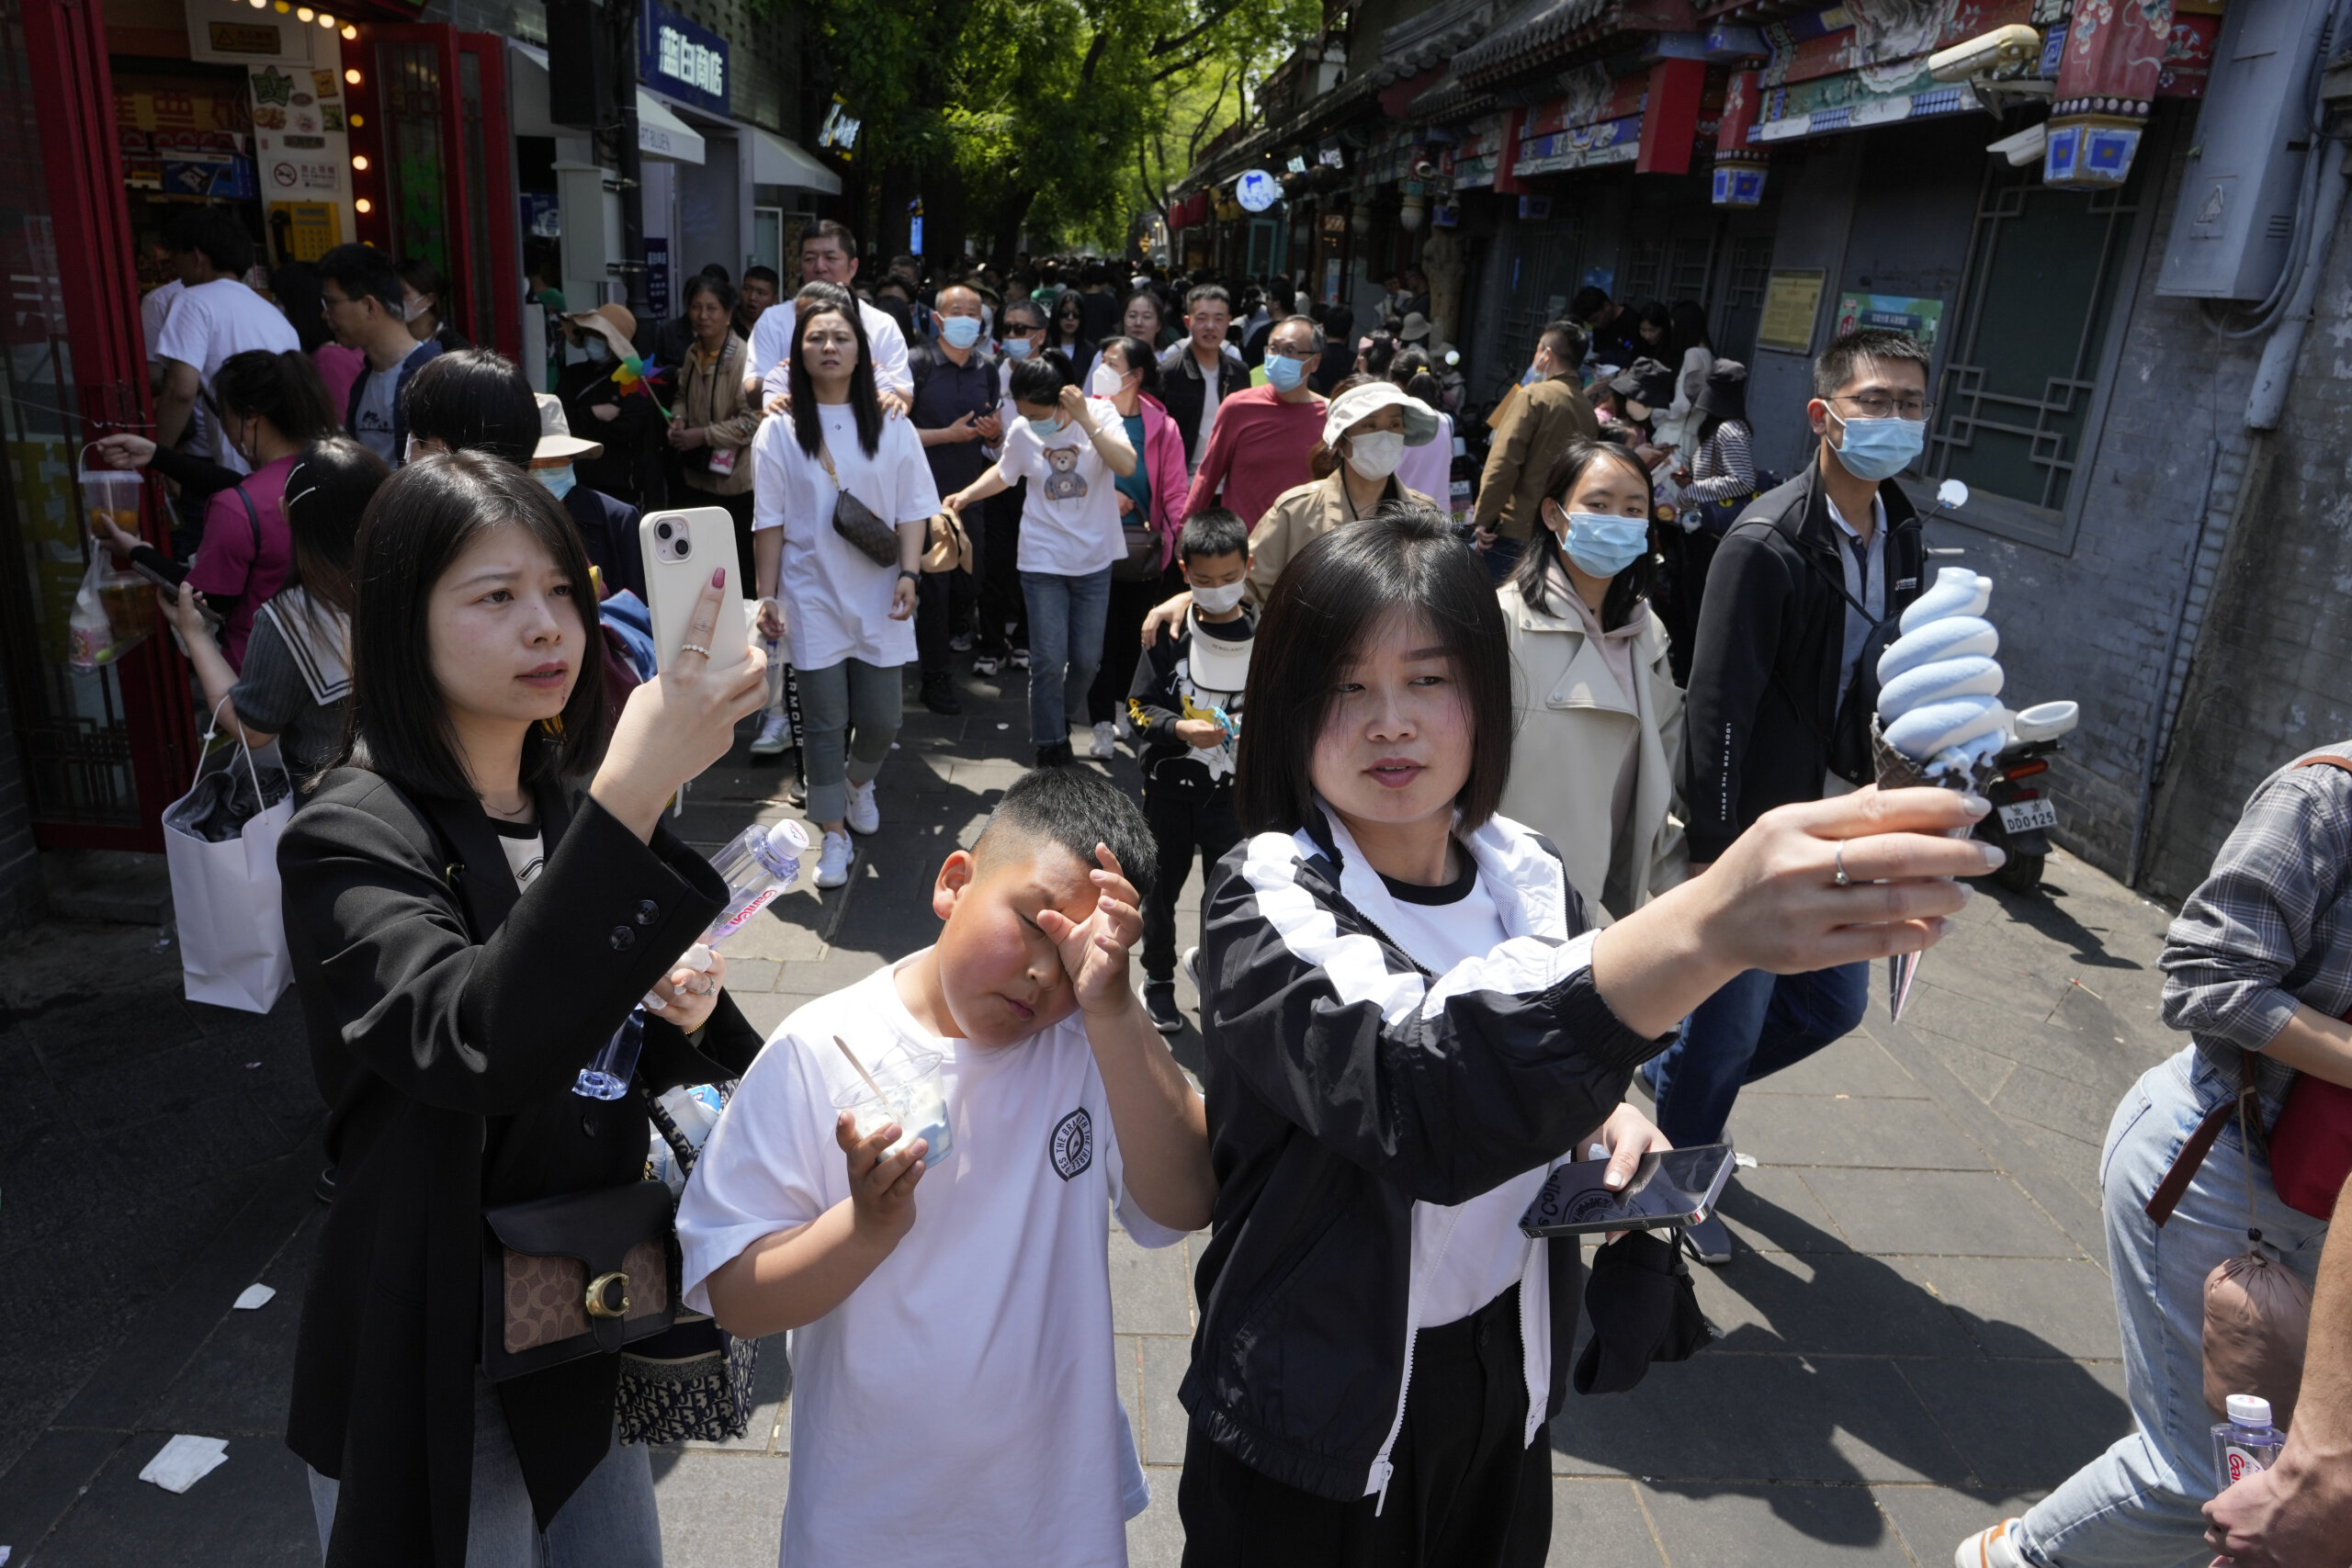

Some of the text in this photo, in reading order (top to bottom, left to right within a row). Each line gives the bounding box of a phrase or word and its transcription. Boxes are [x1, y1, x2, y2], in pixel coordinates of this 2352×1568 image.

[659, 25, 723, 97] 蓝白商店
[787, 668, 805, 748] ARMOUR
[2007, 811, 2053, 830] DD0125
[1056, 1136, 1067, 1154] THE
